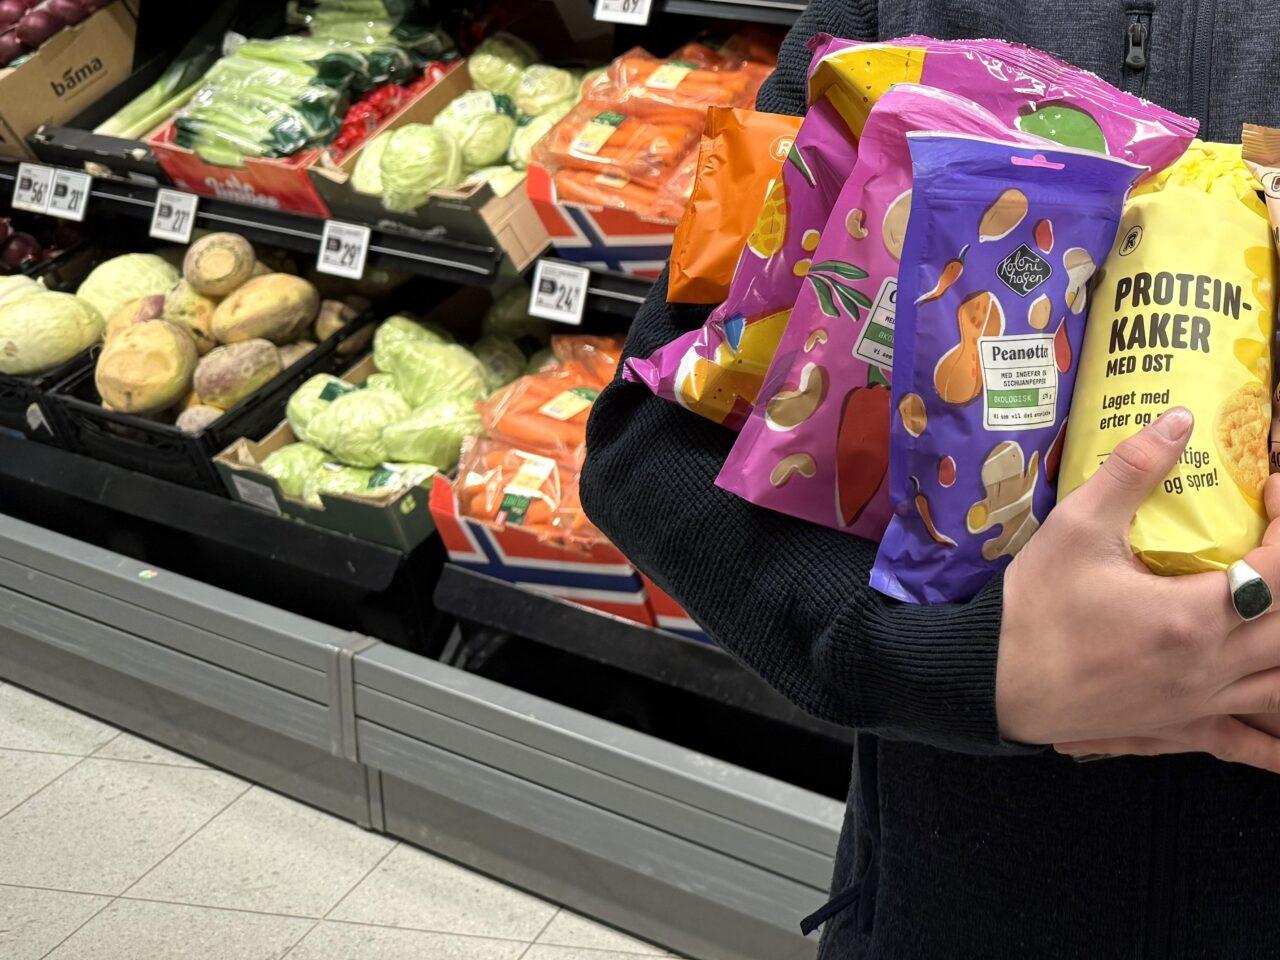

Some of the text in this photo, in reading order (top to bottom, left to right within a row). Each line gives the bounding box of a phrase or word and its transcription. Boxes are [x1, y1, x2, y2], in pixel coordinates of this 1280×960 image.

[1008, 272, 1044, 293] hagen
[1114, 271, 1252, 320] PROTEIN-
[1108, 312, 1211, 354] KAKER
[1106, 353, 1174, 378] MED OST
[1102, 389, 1170, 411] Laget med
[1100, 412, 1151, 430] erter og
[1164, 468, 1219, 495] og sprø!
